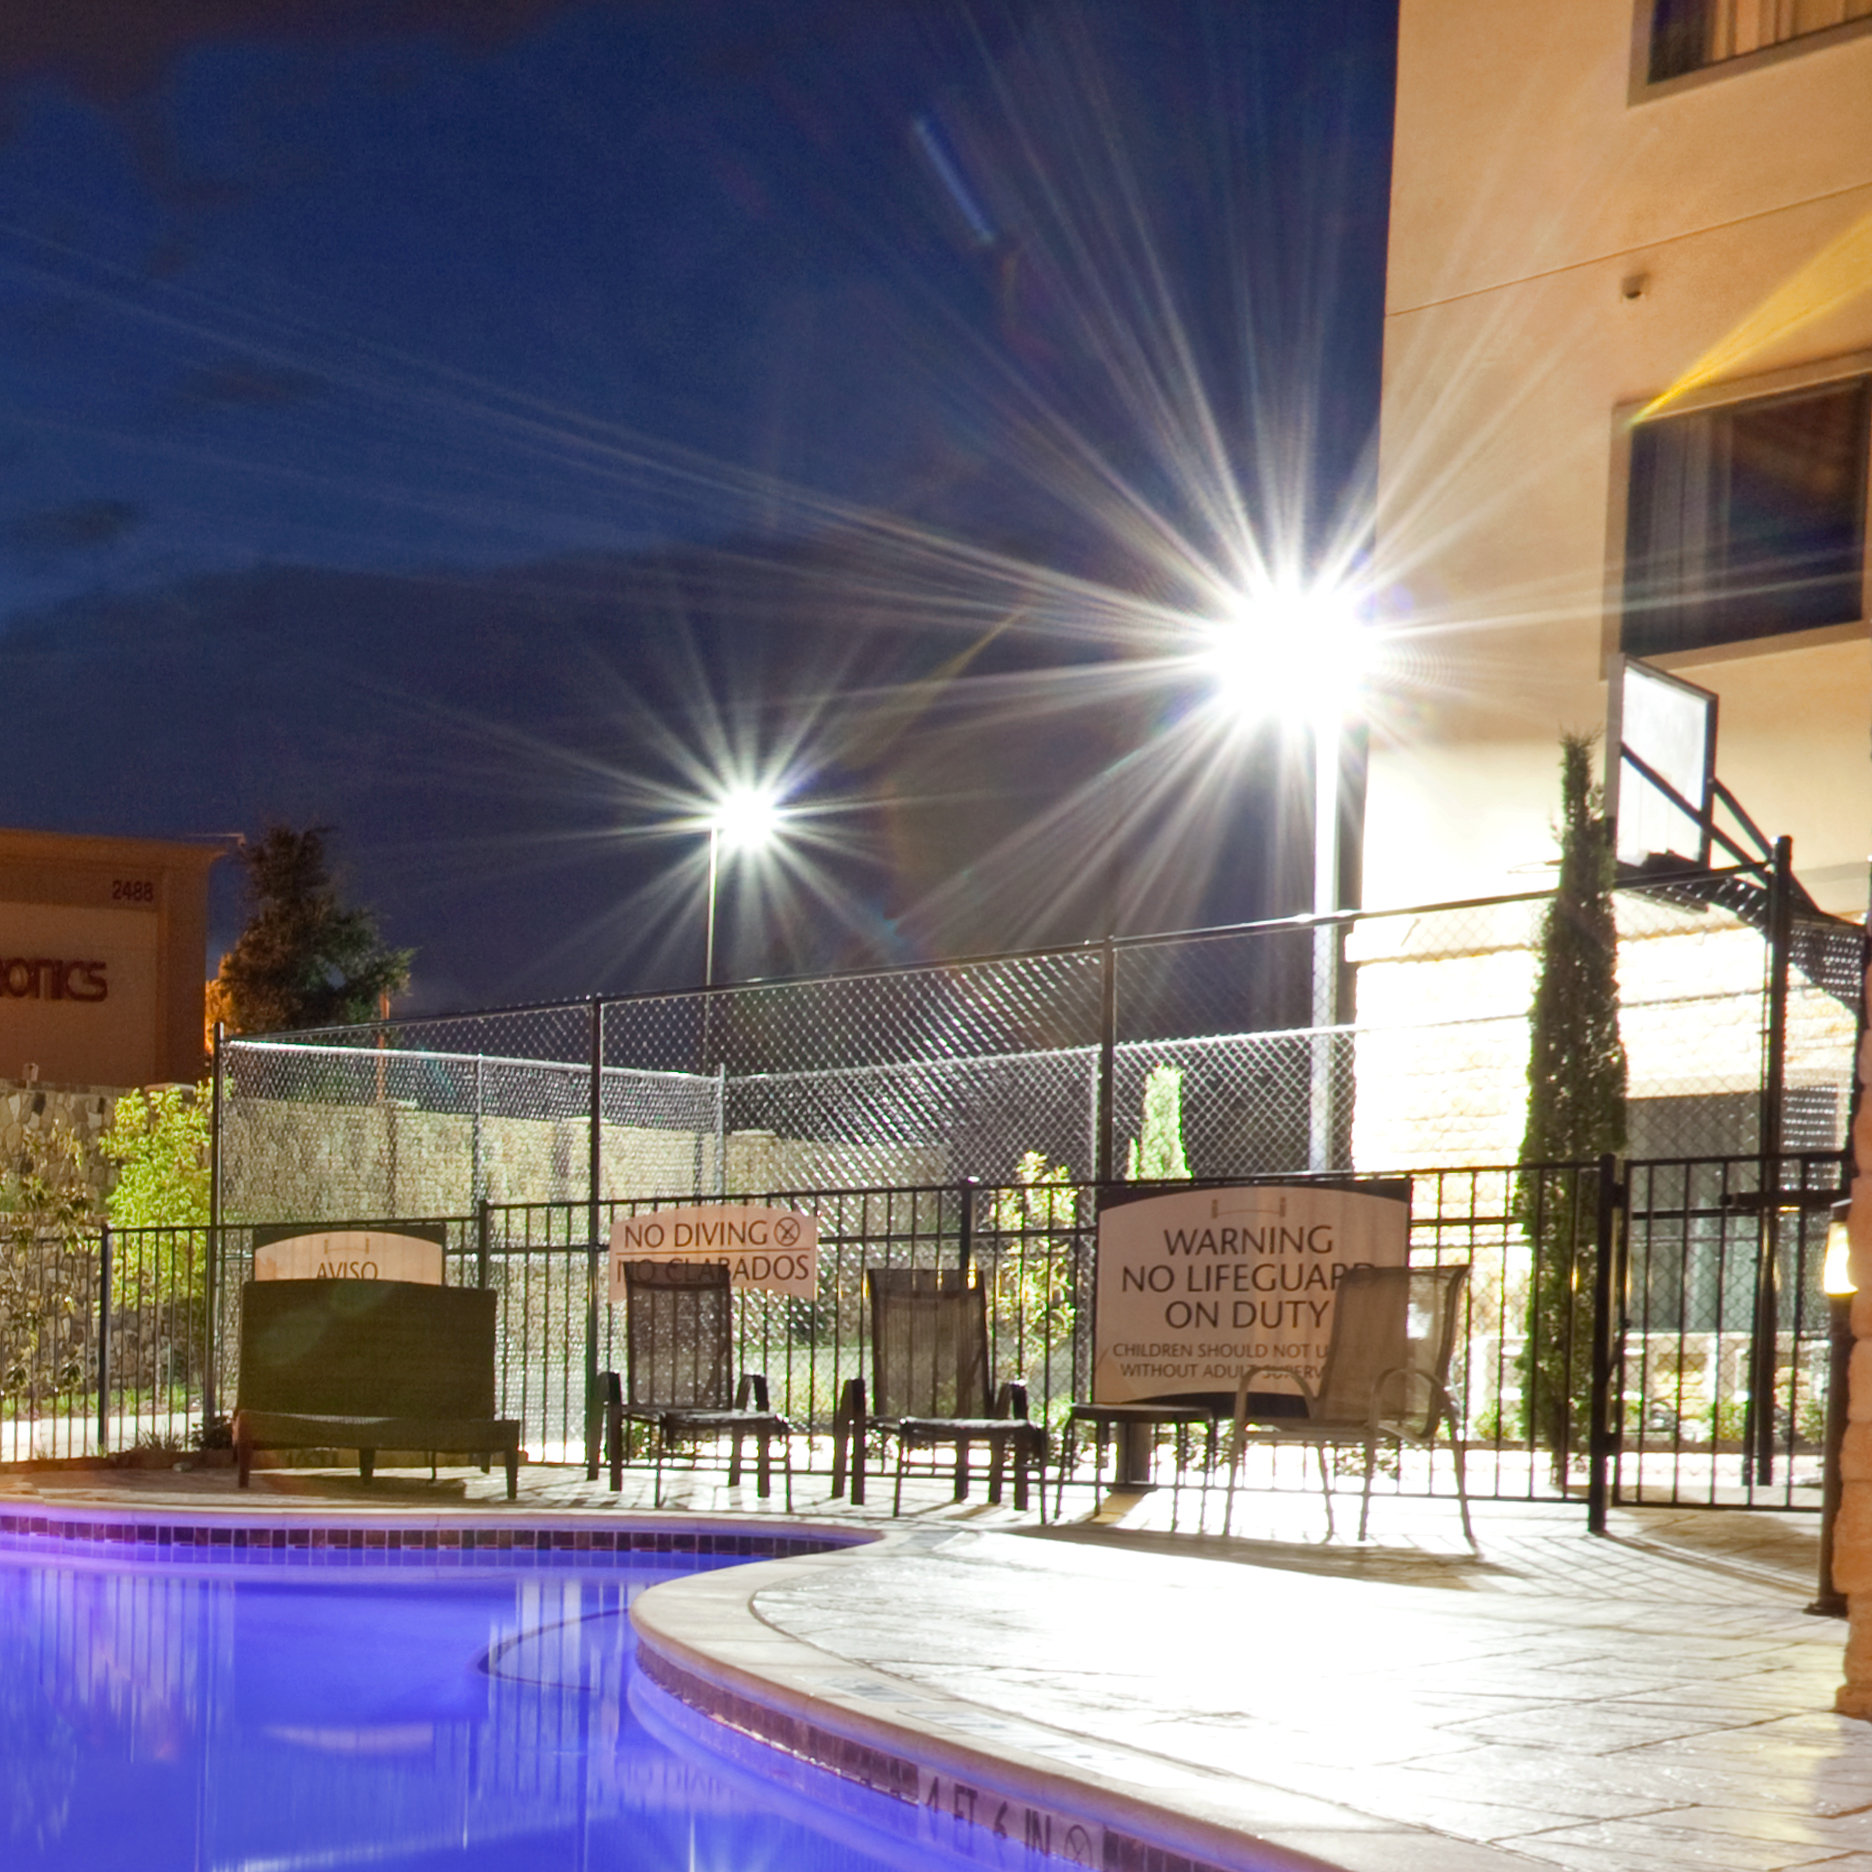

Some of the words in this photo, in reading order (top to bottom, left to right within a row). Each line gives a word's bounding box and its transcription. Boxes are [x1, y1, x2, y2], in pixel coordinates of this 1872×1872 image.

[112, 880, 154, 902] 2488
[625, 1223, 664, 1248] NO
[674, 1219, 768, 1247] DIVING
[1163, 1225, 1333, 1256] WARNING
[1122, 1264, 1175, 1293] NO
[1187, 1262, 1376, 1293] LIFEGUAR
[1164, 1301, 1219, 1329] ON
[1232, 1301, 1330, 1329] DUTY
[1113, 1342, 1194, 1358] CHILDREN
[1197, 1343, 1269, 1359] SHOULD
[1273, 1343, 1311, 1359] NOT
[1120, 1363, 1198, 1378] WITHOUT
